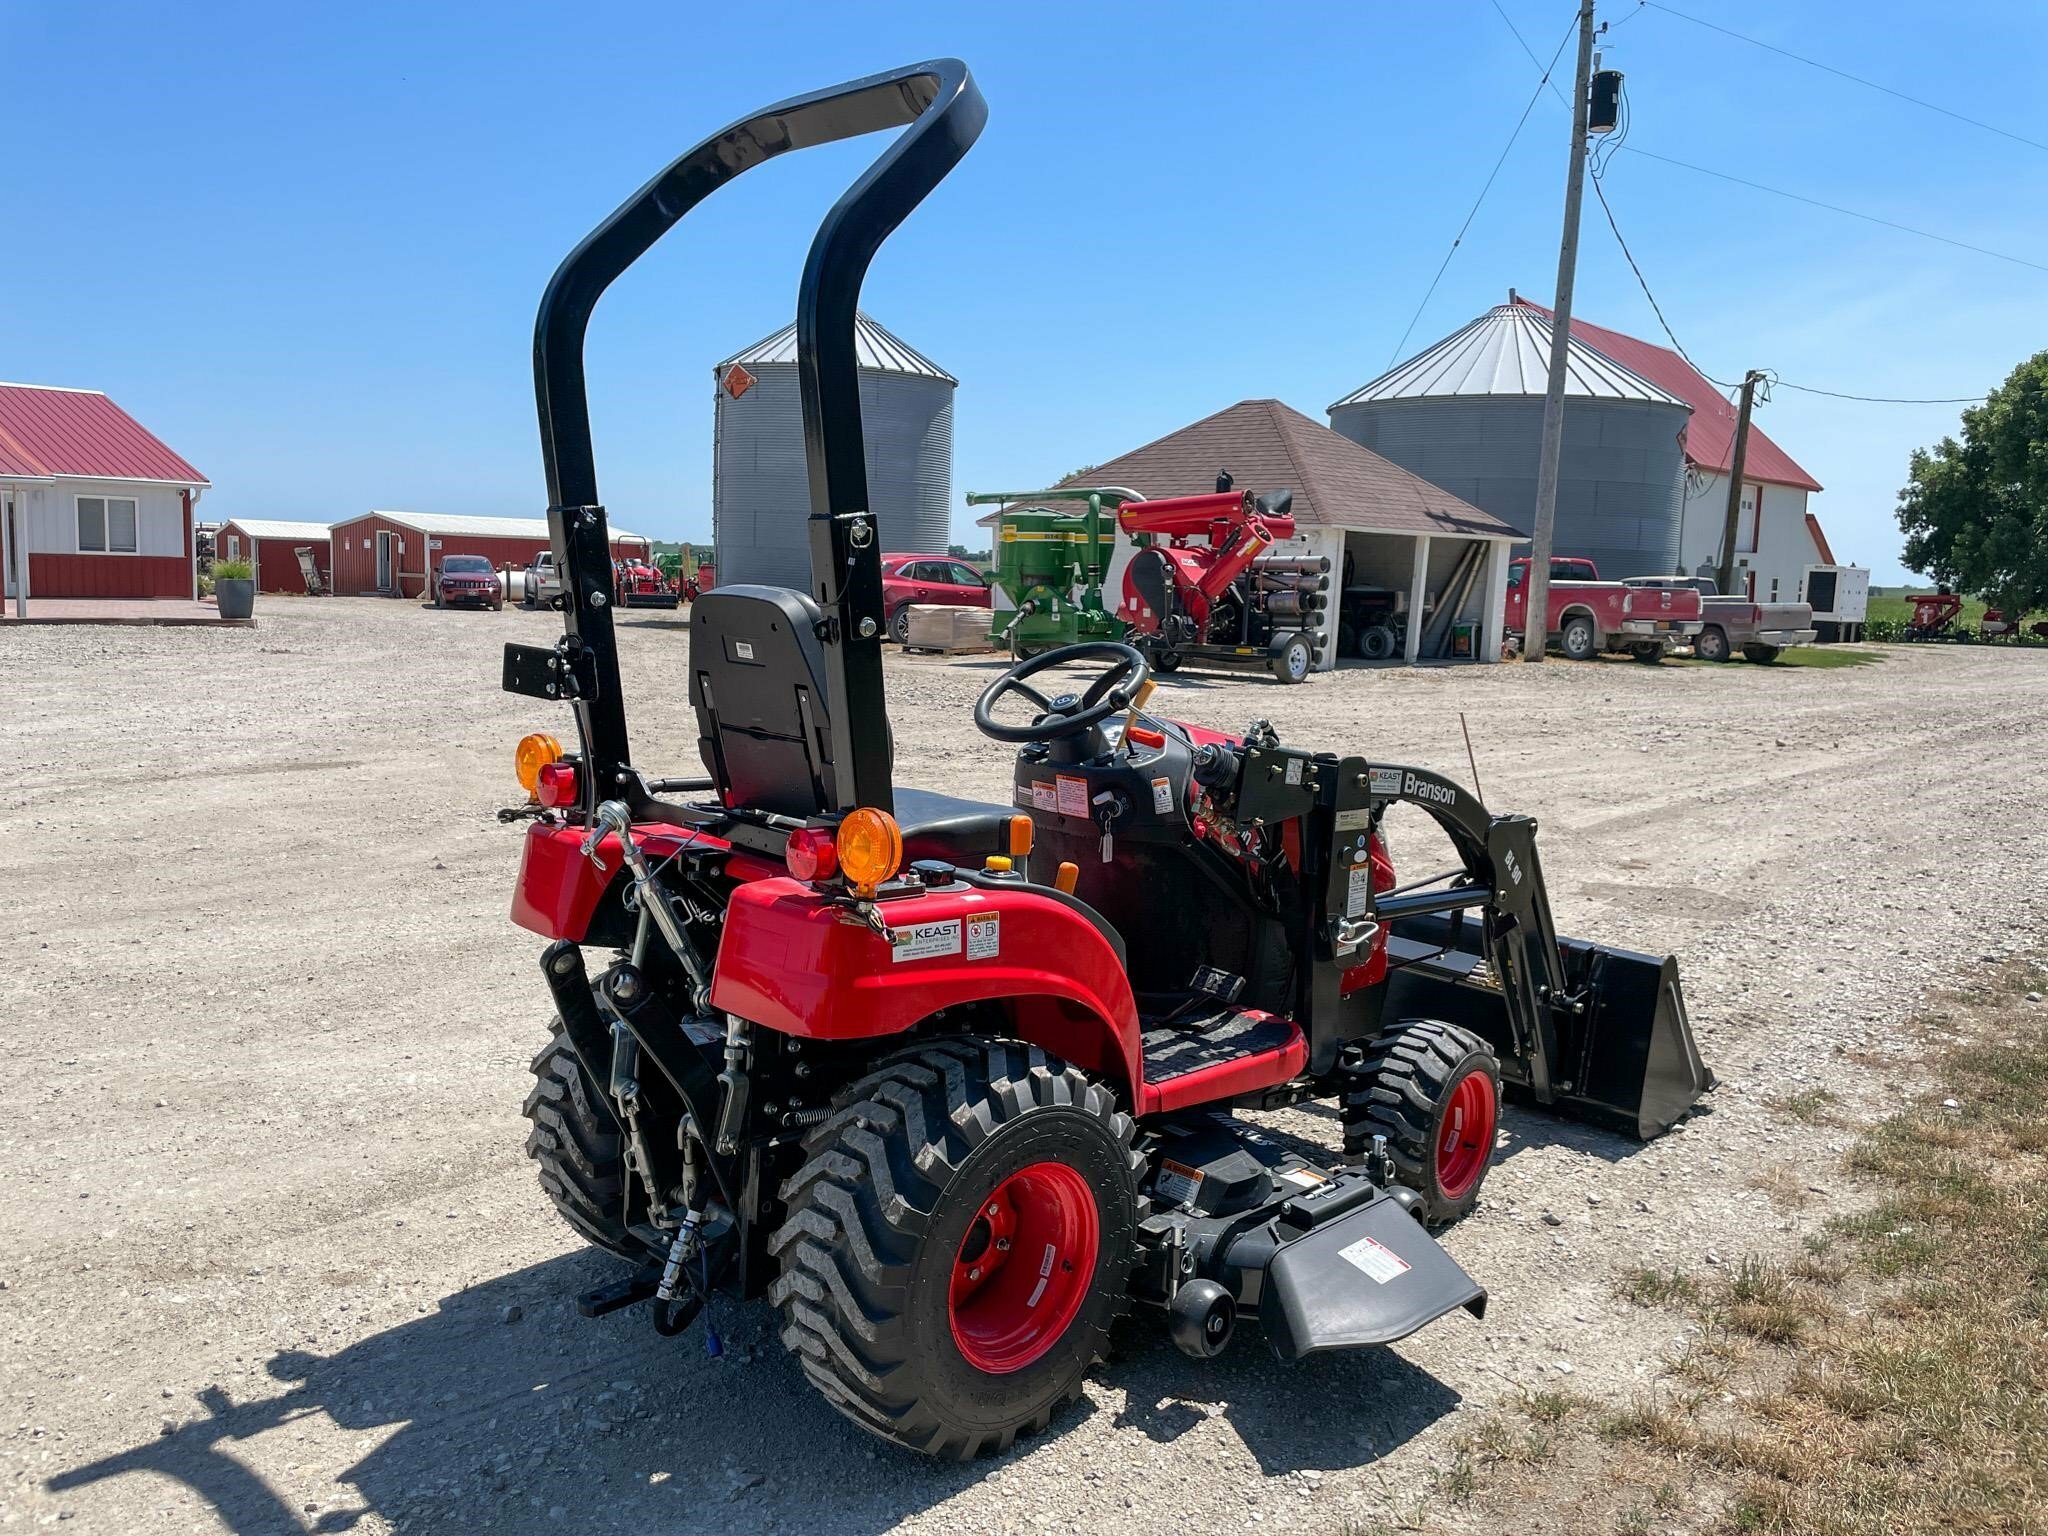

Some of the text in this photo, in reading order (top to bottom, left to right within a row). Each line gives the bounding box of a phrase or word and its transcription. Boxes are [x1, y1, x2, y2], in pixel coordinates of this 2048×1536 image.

[1380, 772, 1401, 780] KEAST
[1404, 772, 1456, 805] Branson
[1505, 849, 1522, 885] BL 90
[915, 924, 960, 939] KEAST
[915, 935, 950, 945] ENTERPRISES
